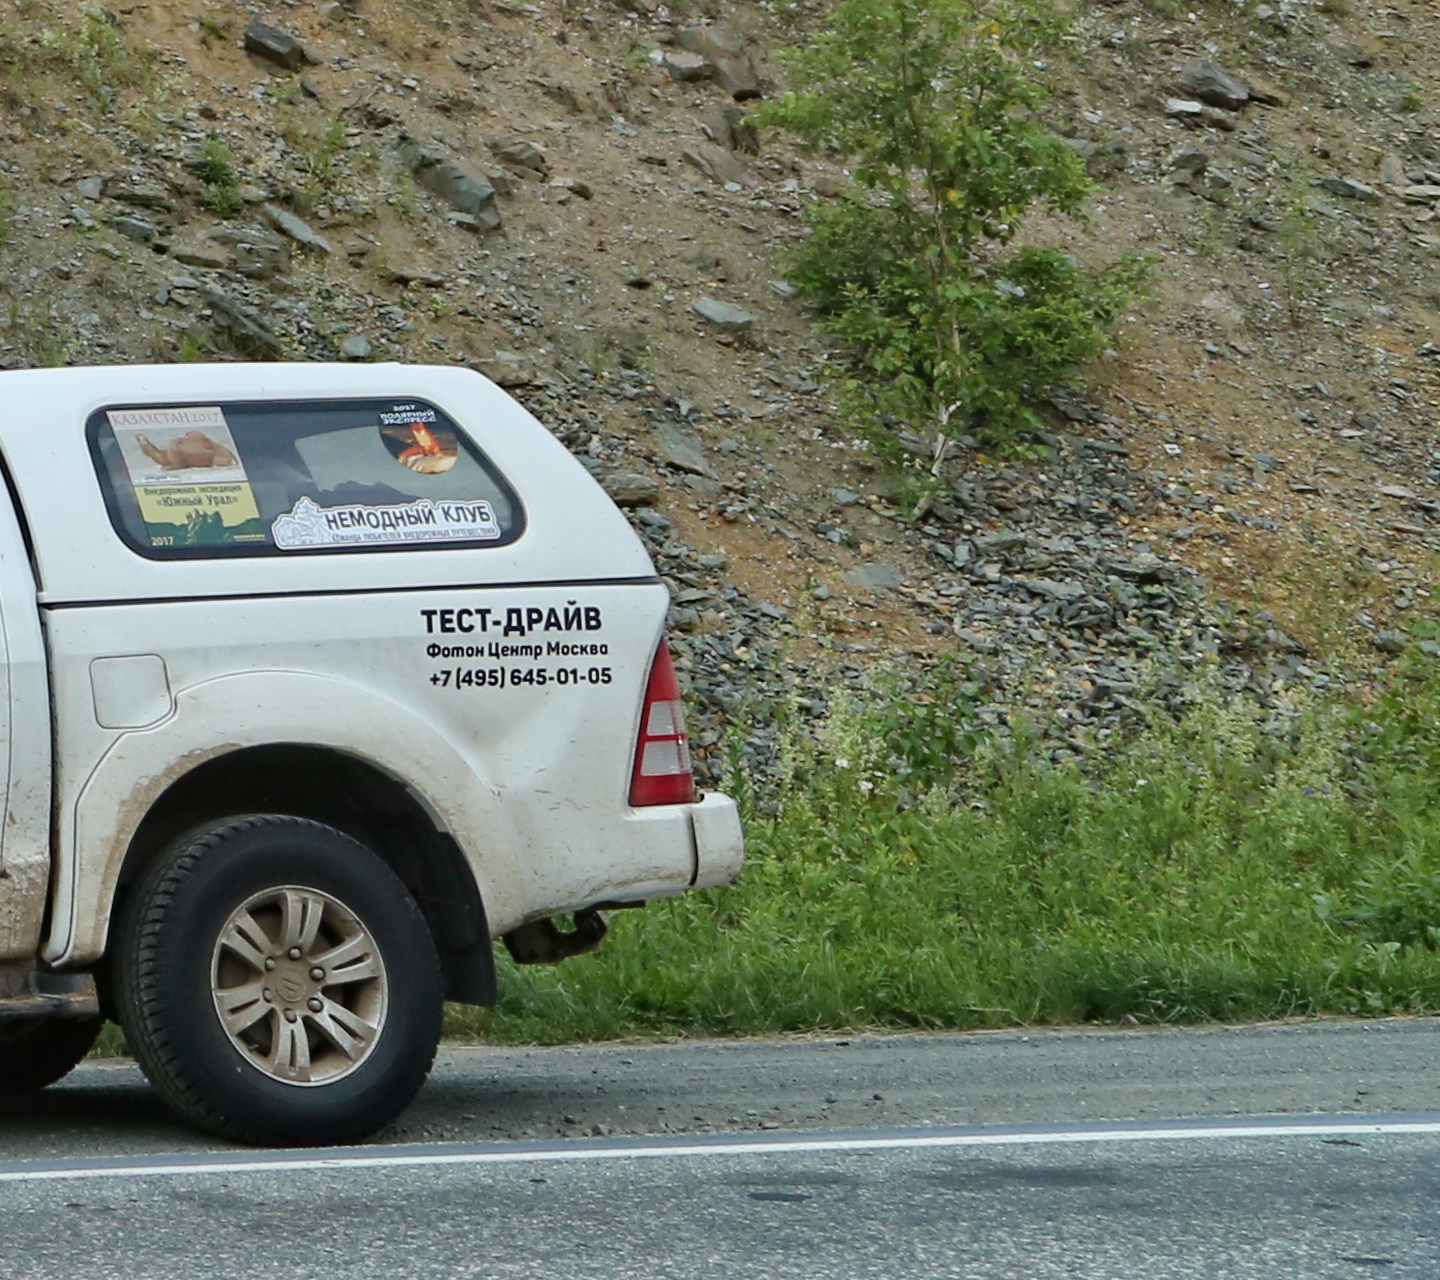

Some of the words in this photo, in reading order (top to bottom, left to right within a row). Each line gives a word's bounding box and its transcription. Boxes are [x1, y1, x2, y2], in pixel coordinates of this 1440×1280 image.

[111, 412, 189, 426] КАЗАХСТАН
[193, 412, 220, 423] 2017
[325, 505, 437, 531] НЕМОДНЫЙ
[441, 505, 491, 523] КЛУБ
[151, 536, 175, 546] 2017
[420, 599, 602, 637] ТЕСТ-ДРАЙВ
[426, 642, 484, 658] Фотон
[488, 642, 543, 660] Центр
[546, 641, 609, 657] Москва
[430, 670, 452, 687] +7
[456, 666, 506, 690] (495)
[510, 667, 612, 686] 645-01-05
